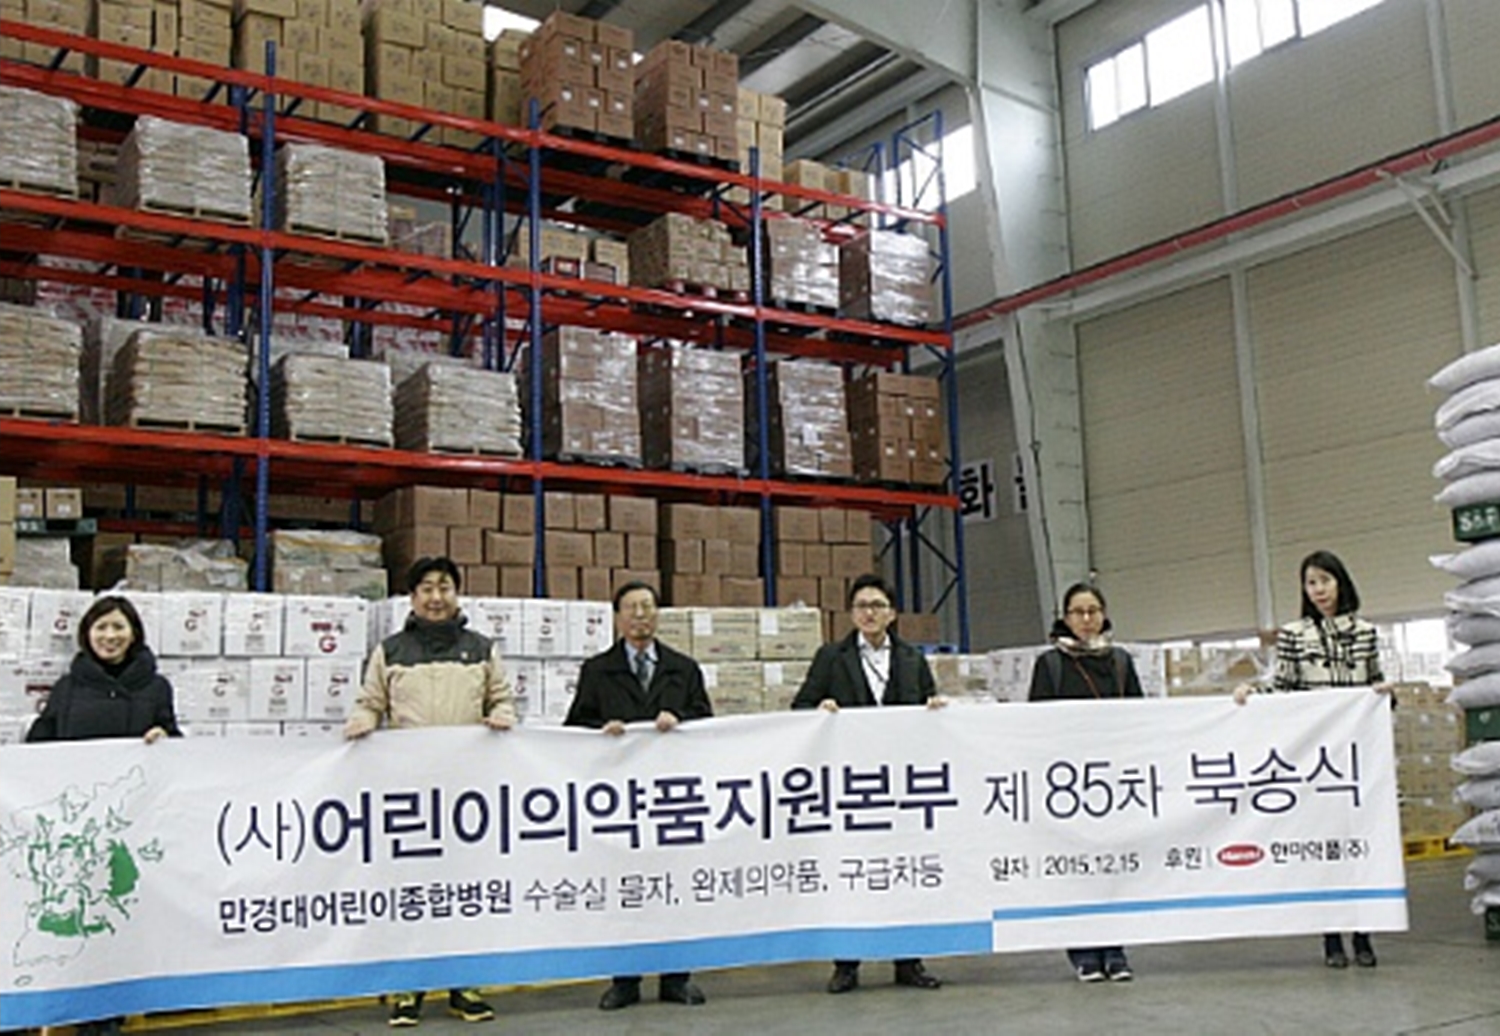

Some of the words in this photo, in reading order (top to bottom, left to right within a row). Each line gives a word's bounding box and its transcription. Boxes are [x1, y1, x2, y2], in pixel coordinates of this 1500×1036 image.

[318, 635, 337, 653] G
[216, 763, 959, 864] (사)어린이의약품지원본부
[984, 770, 1030, 822] 제
[1045, 761, 1162, 819] 85차
[1186, 743, 1361, 814] 북송식
[219, 880, 512, 934] 만경대어린이종합병원
[523, 877, 607, 912] 수술실
[839, 854, 944, 890] 구급차등
